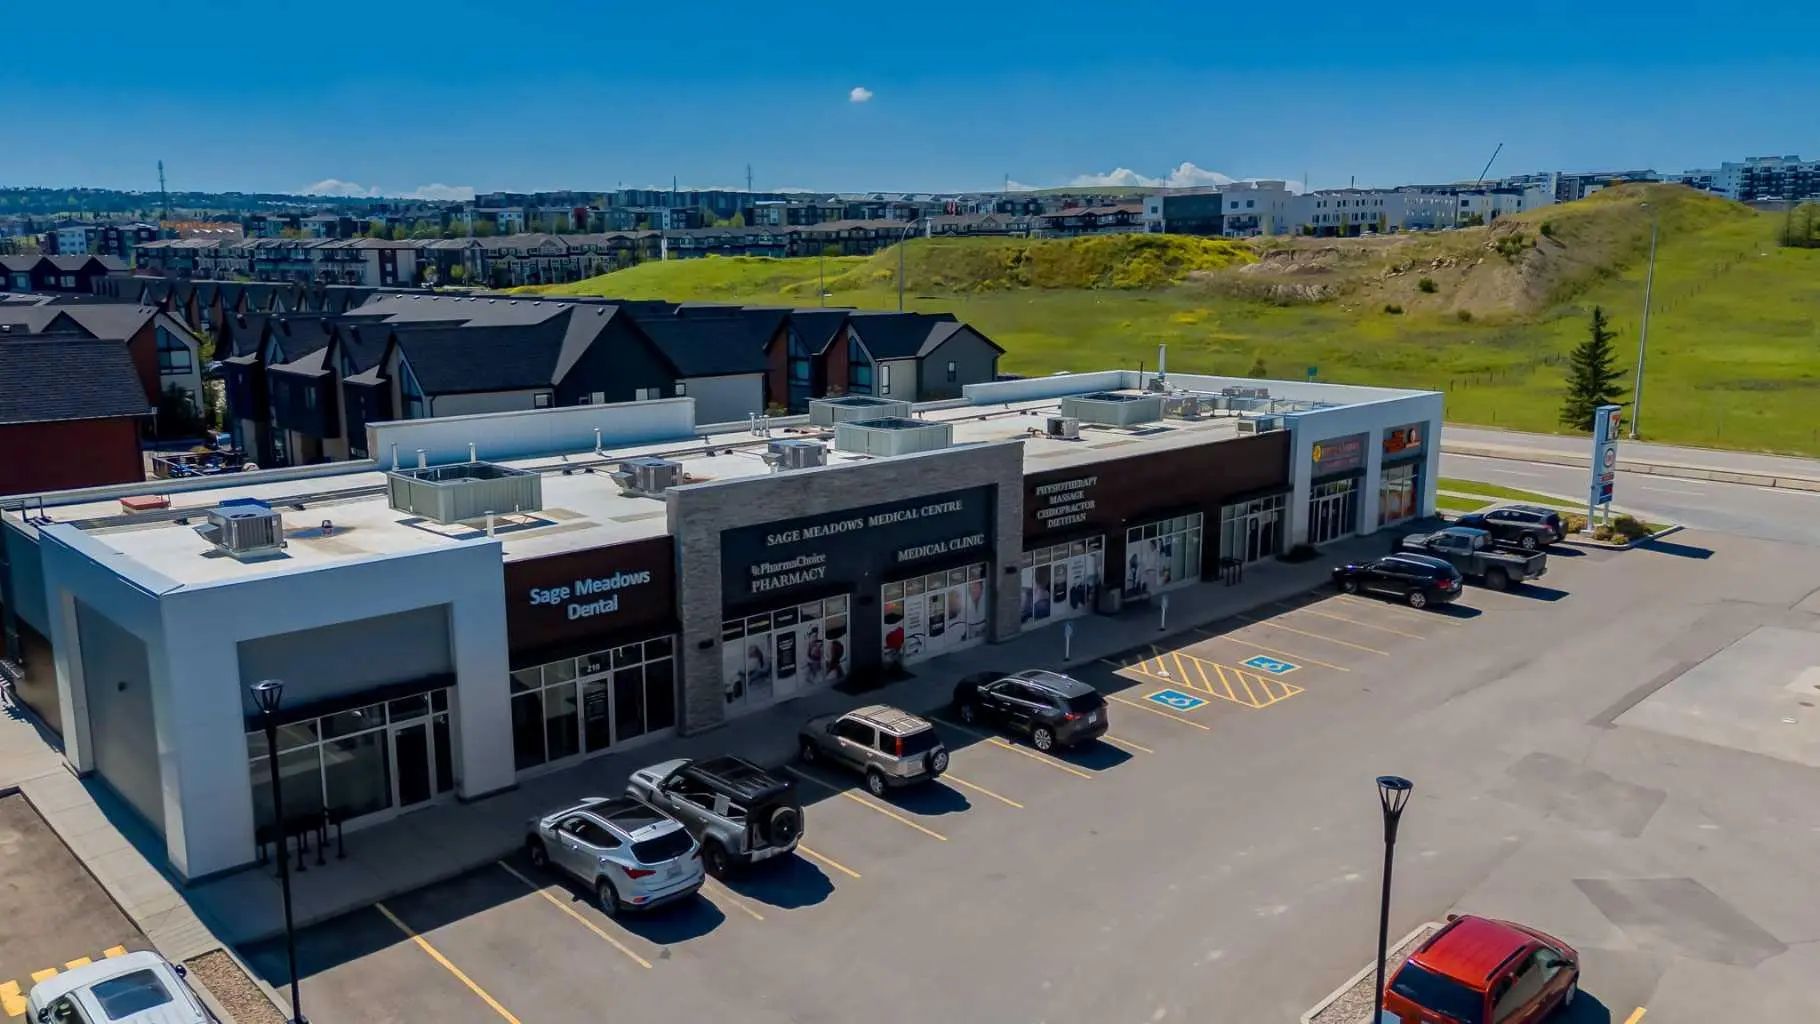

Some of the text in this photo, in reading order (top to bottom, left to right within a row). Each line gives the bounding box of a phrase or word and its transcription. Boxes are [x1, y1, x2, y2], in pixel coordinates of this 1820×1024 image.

[1035, 476, 1098, 496] PHYSIOTHERAPY
[1049, 490, 1085, 505] MASSAGE
[767, 500, 963, 546] SAGE MEADOWS MEDICAL CENTRE
[1036, 500, 1096, 520] CHIROPRACTOR
[897, 534, 985, 562] MEDICAL CLINIC
[529, 570, 651, 605] Sage Meadows
[752, 566, 827, 593] PHARMACY
[567, 595, 619, 620] Dental
